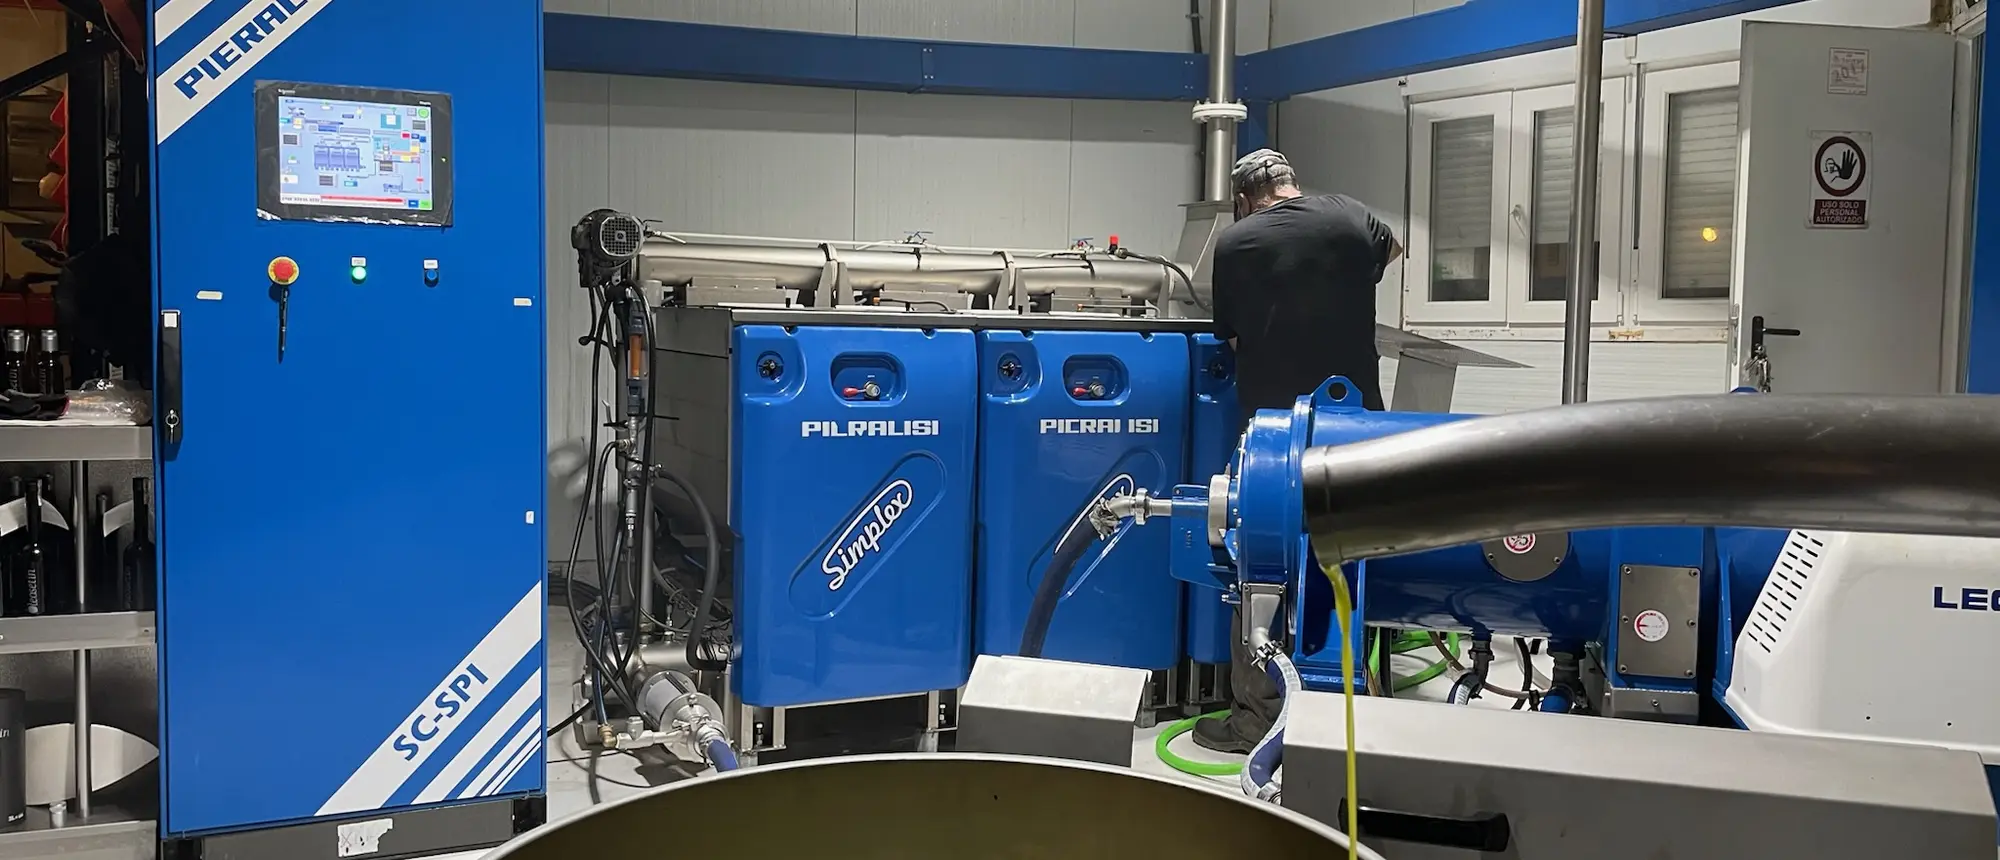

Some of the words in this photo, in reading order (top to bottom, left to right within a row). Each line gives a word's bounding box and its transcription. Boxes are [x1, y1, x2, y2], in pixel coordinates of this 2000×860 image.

[1820, 208, 1860, 216] PERSONAL
[1821, 200, 1838, 208] USO
[822, 479, 913, 591] Simplex
[393, 663, 489, 761] SC-SPI
